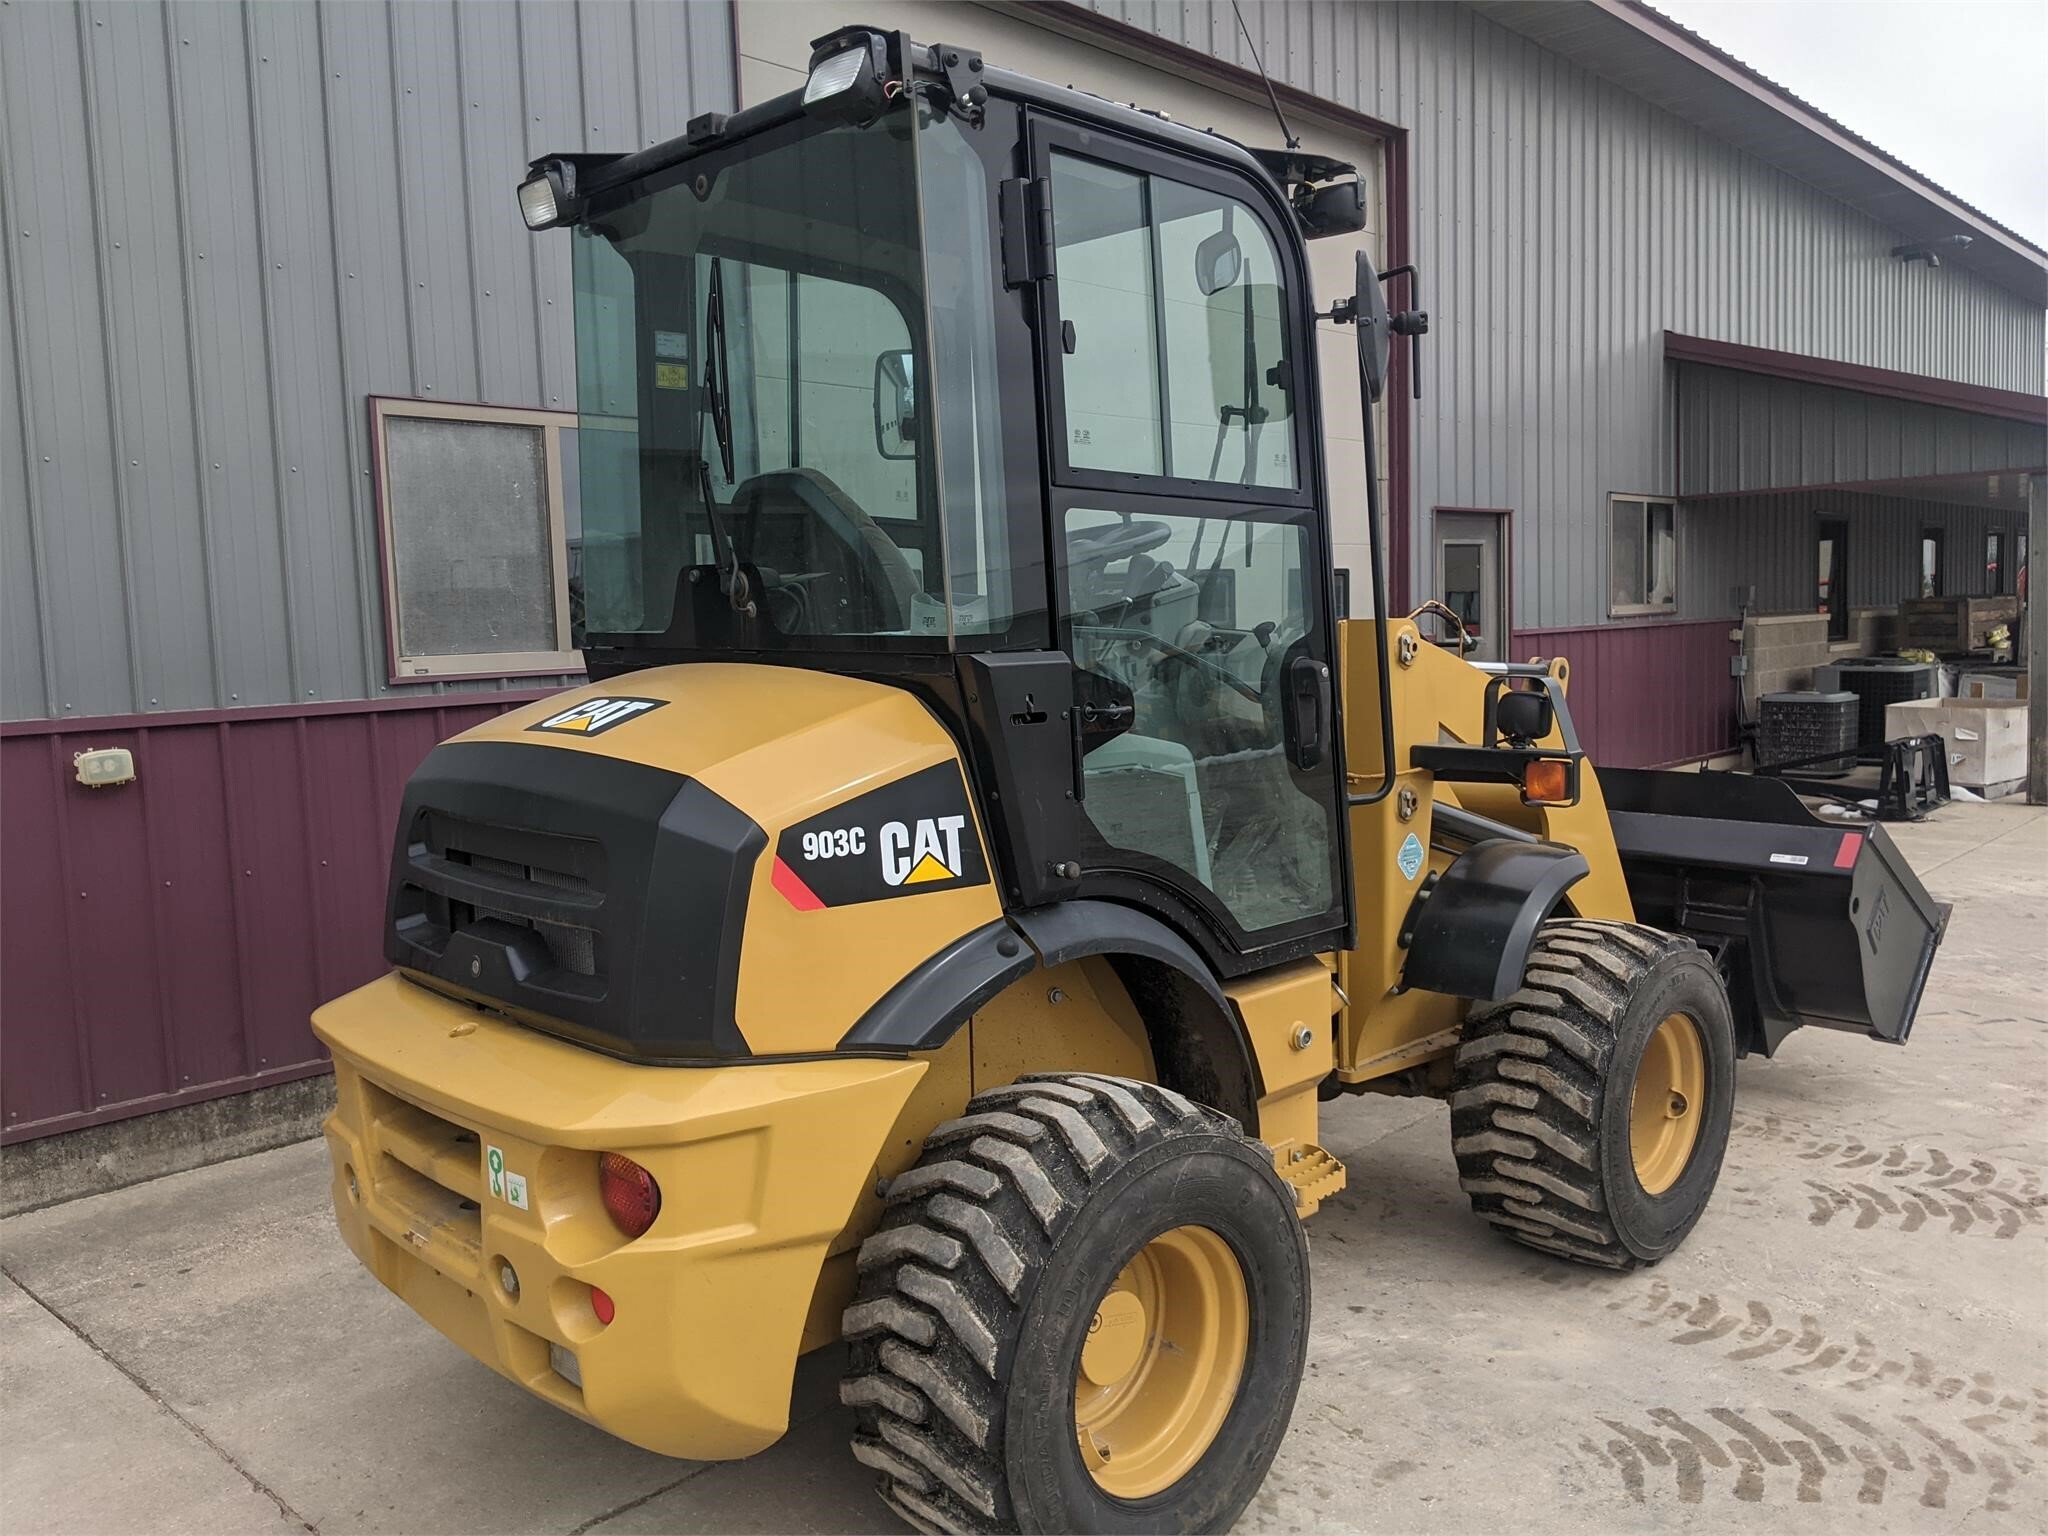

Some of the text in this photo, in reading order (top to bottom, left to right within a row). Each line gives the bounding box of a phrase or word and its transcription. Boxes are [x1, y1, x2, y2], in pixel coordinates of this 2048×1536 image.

[541, 699, 646, 732] CAT
[803, 815, 965, 886] 903C CAT
